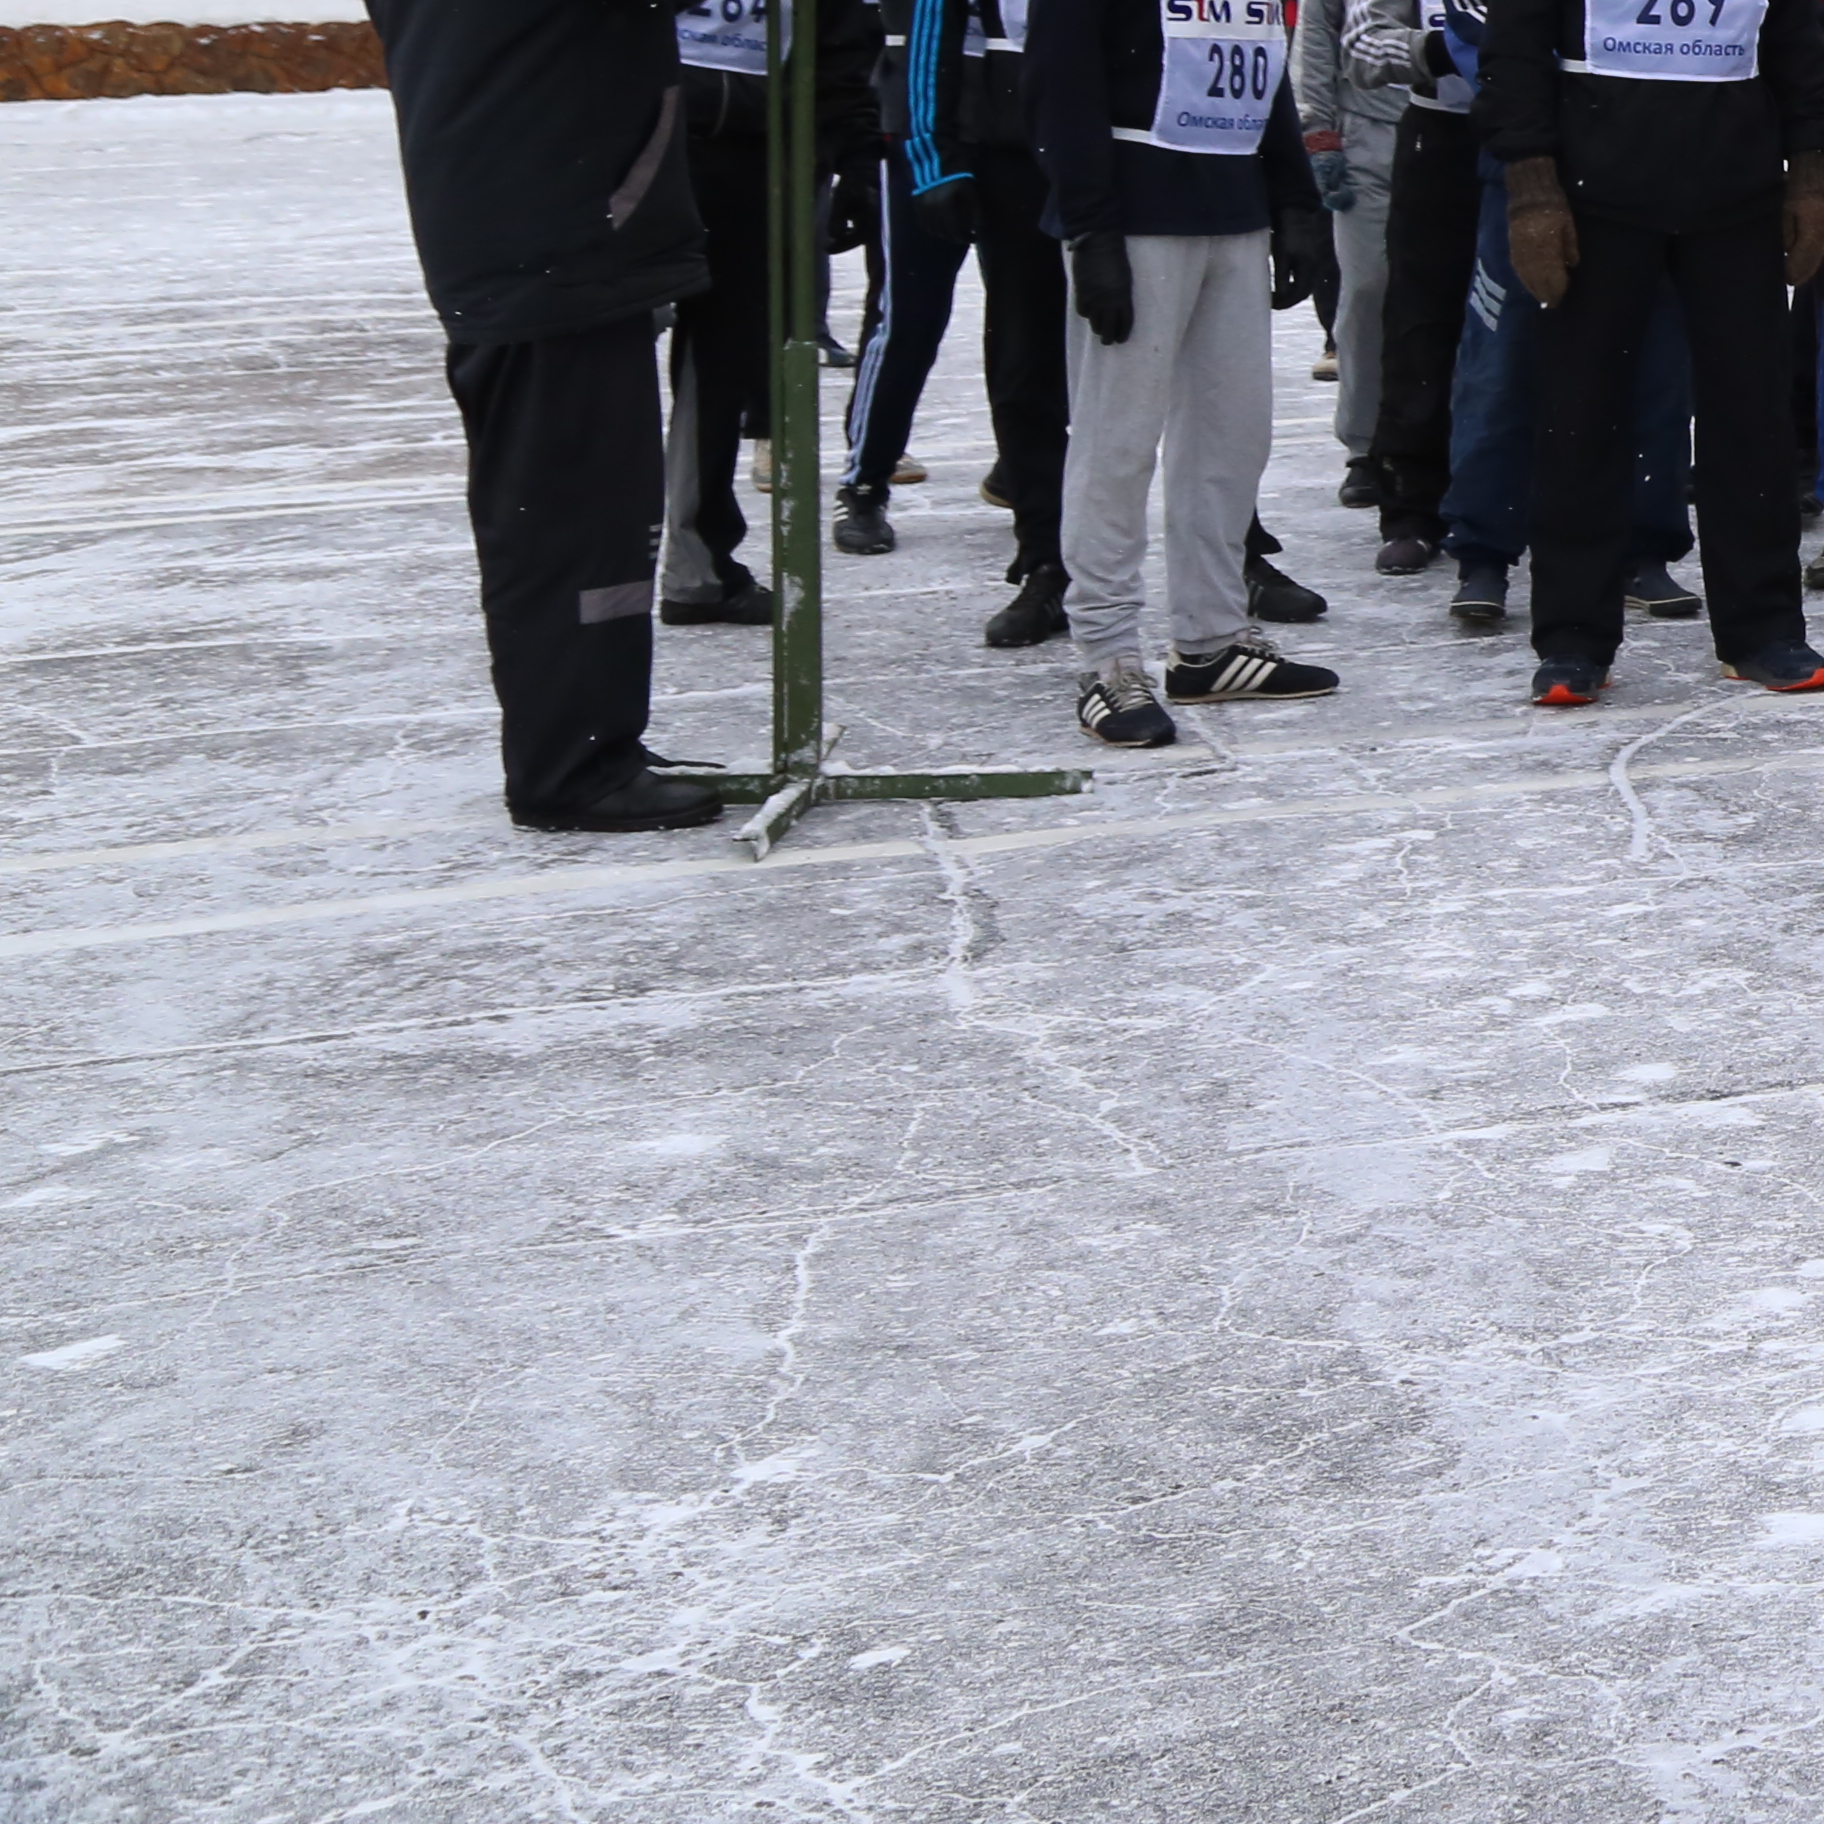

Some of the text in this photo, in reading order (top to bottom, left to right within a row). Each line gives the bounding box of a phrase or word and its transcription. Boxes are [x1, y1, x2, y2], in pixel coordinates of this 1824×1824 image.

[1603, 37, 1746, 57] Омская область
[1207, 43, 1269, 100] 280
